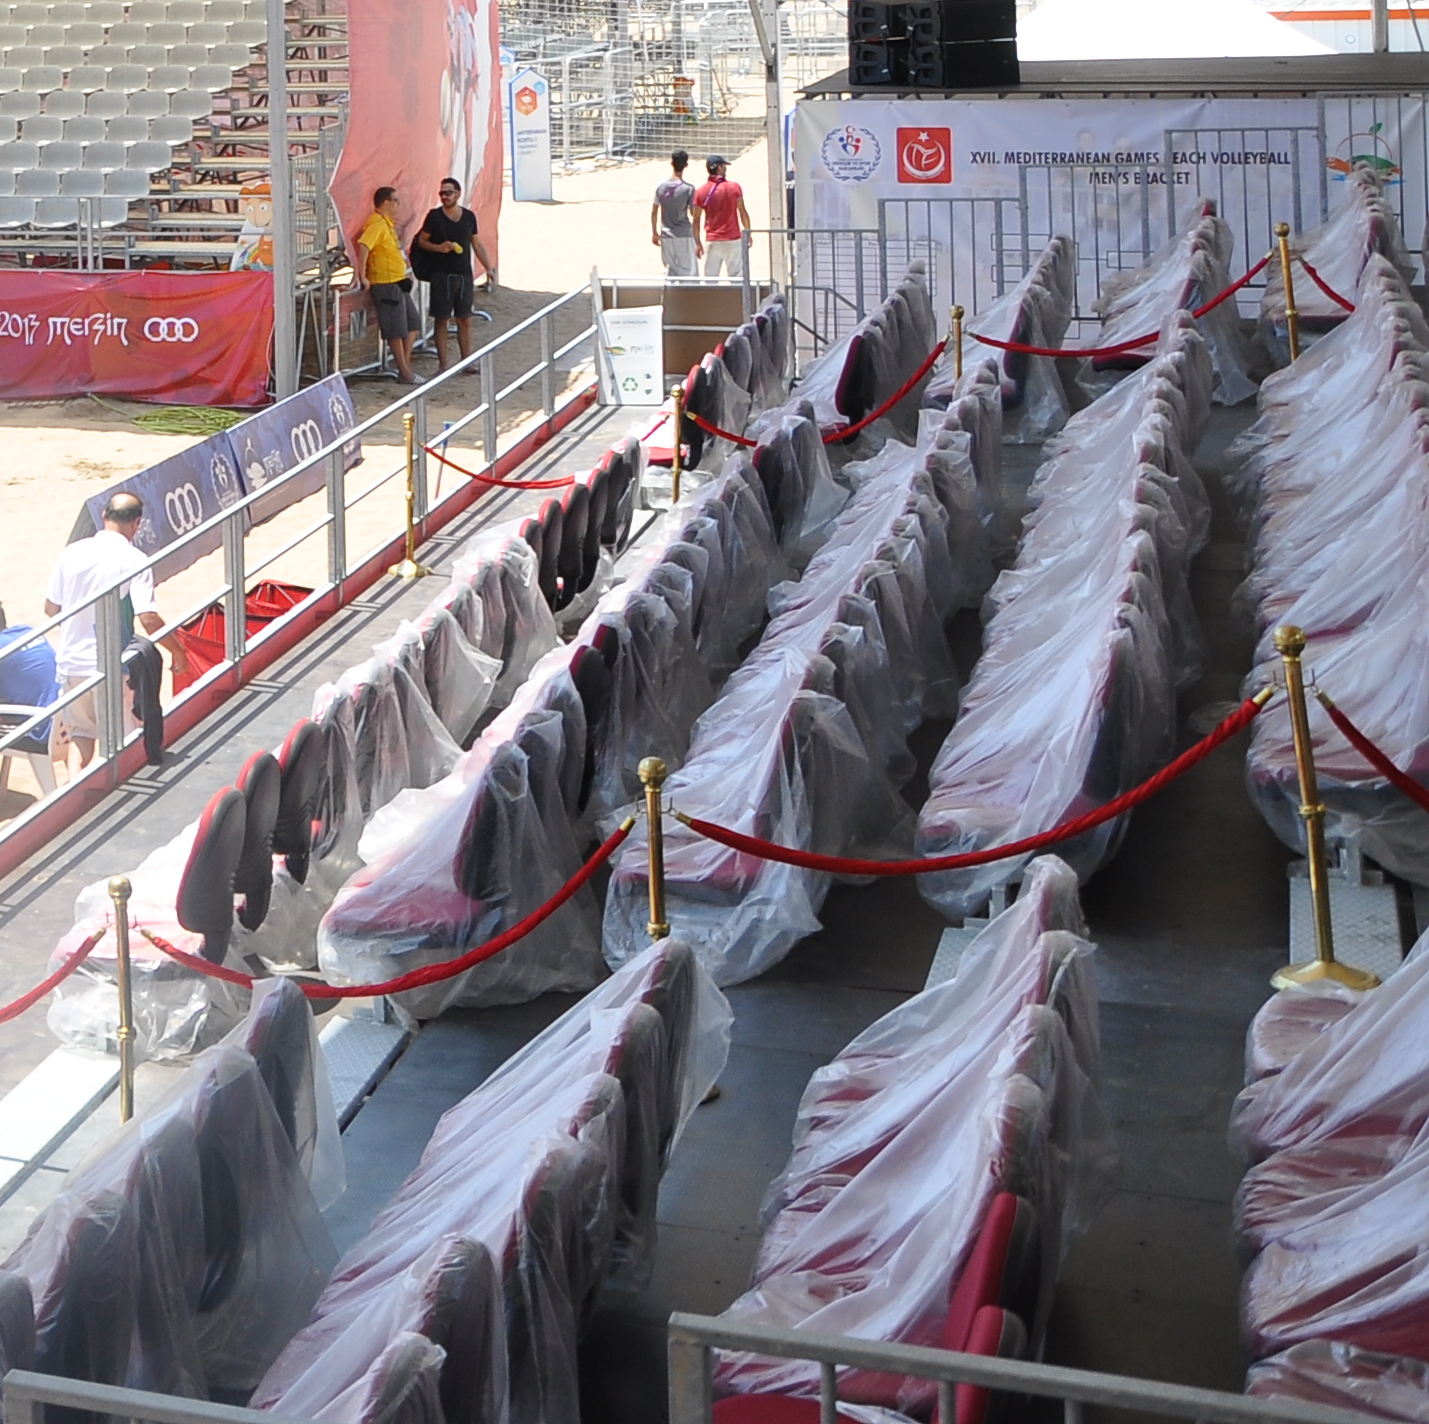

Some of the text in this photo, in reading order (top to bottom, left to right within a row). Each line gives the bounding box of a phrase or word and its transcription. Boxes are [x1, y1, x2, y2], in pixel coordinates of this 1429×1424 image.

[1004, 151, 1111, 165] MEDITERRANEAN
[1114, 151, 1160, 165] GAMES
[1167, 151, 1207, 165] EACH
[1209, 151, 1290, 165] VOLLEYBALL
[1134, 171, 1191, 185] BRACET
